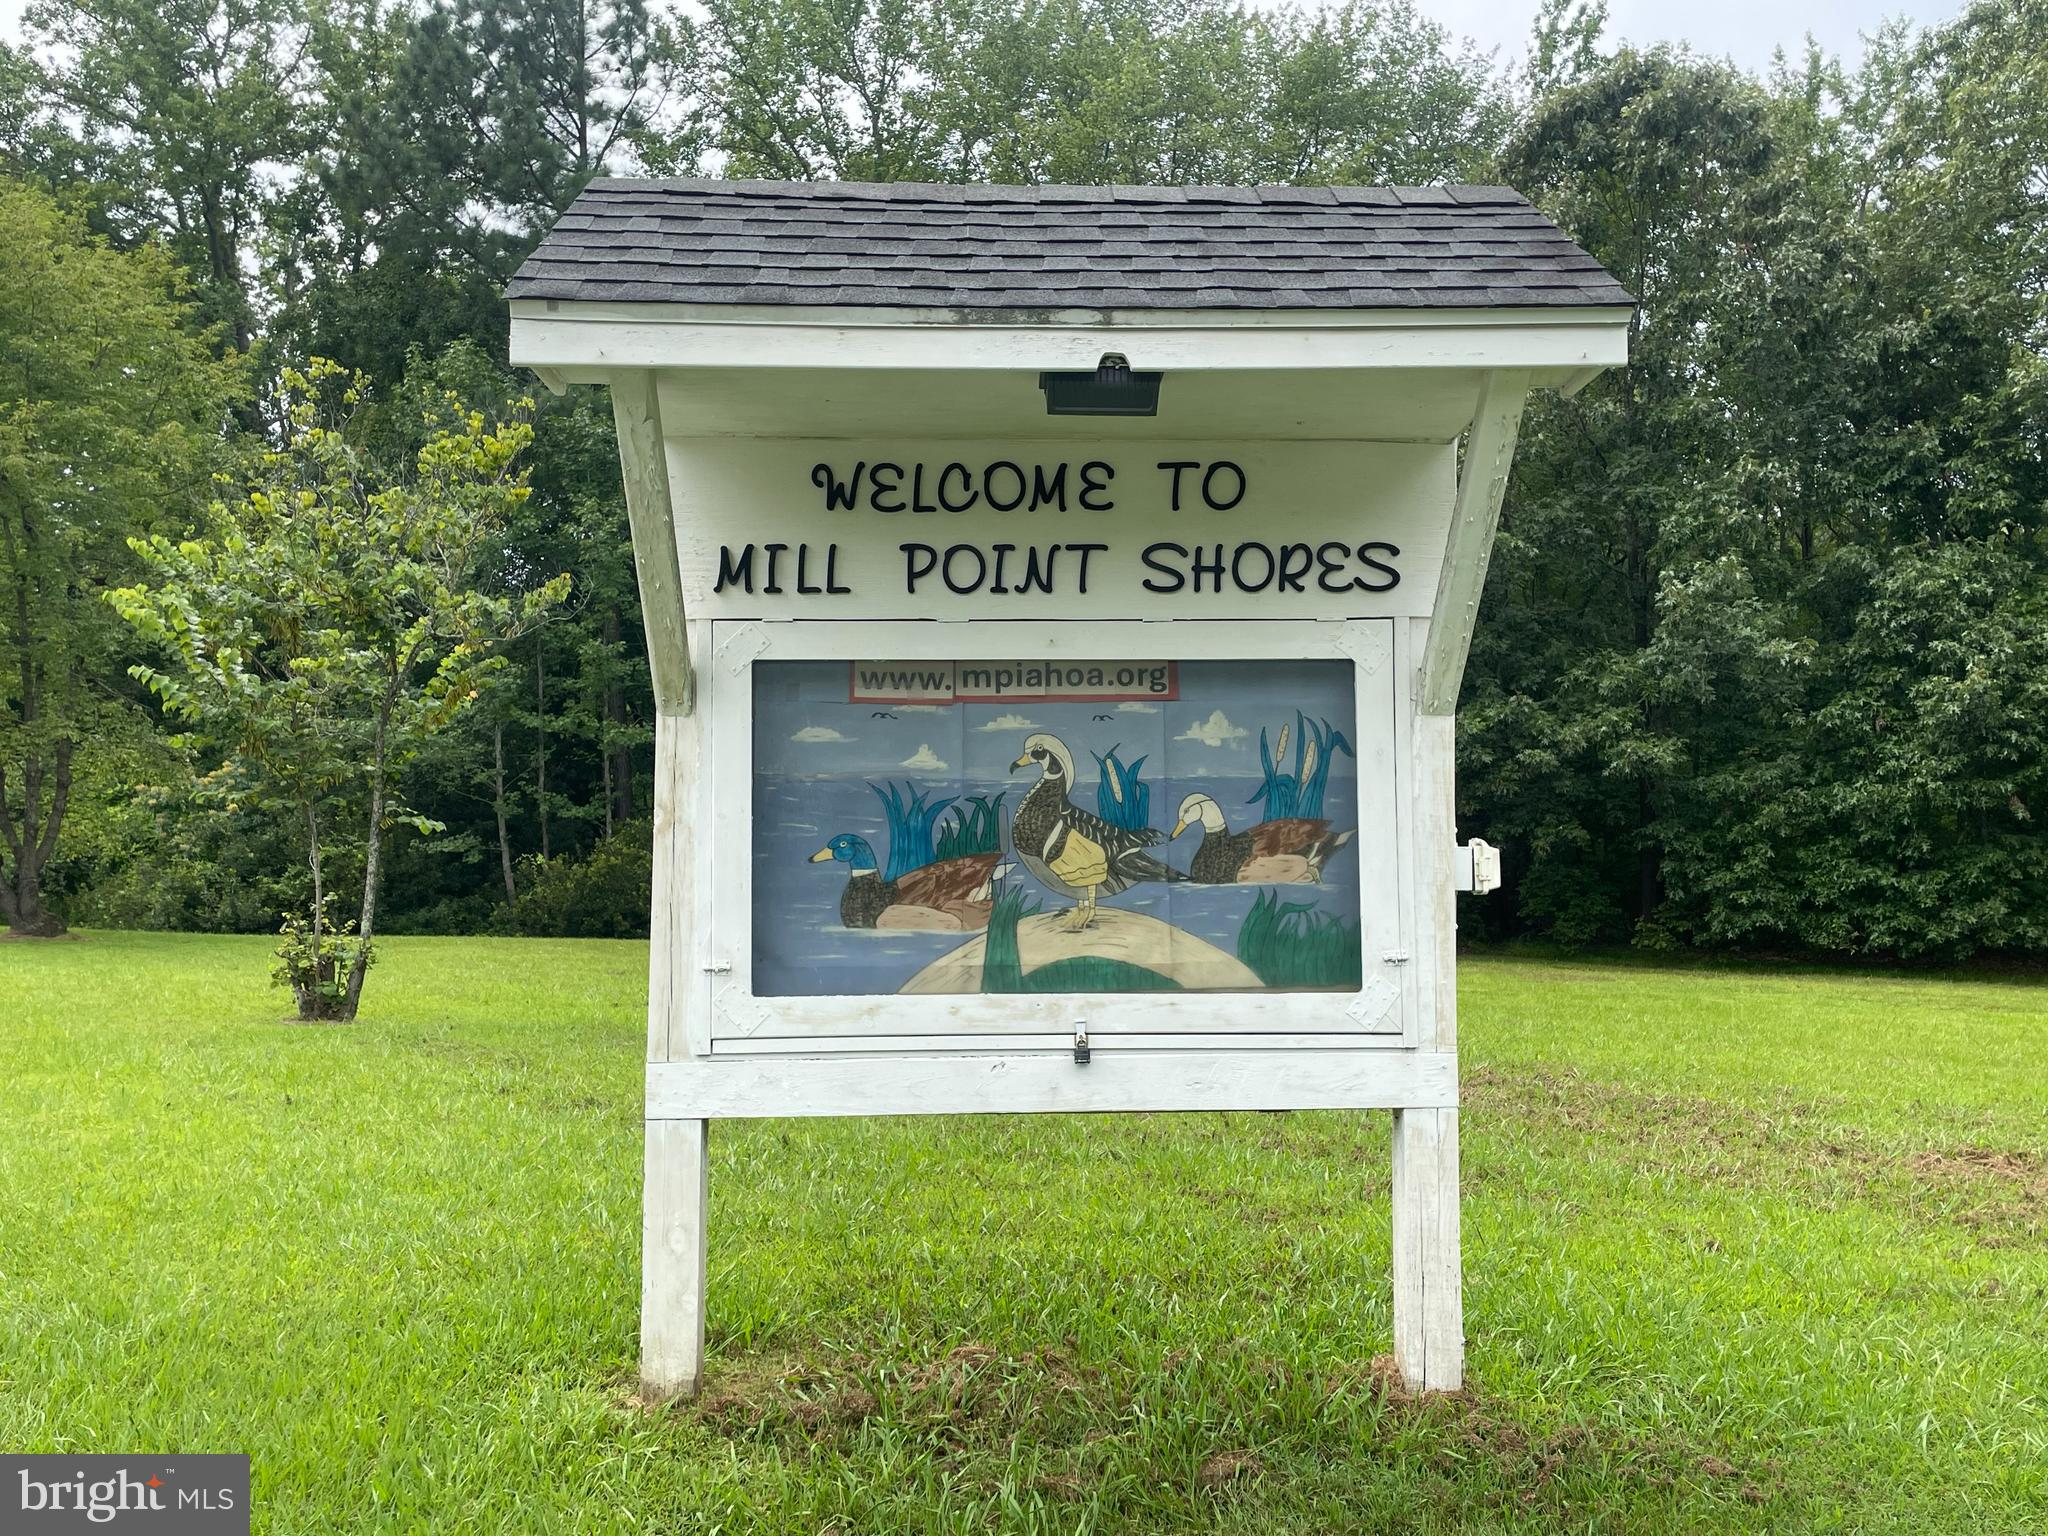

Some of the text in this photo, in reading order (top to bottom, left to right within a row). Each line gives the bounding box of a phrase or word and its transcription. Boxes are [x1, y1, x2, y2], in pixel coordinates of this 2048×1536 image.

[811, 460, 1247, 513] WELCOME TO
[713, 541, 1402, 594] MILL POINT SHORES
